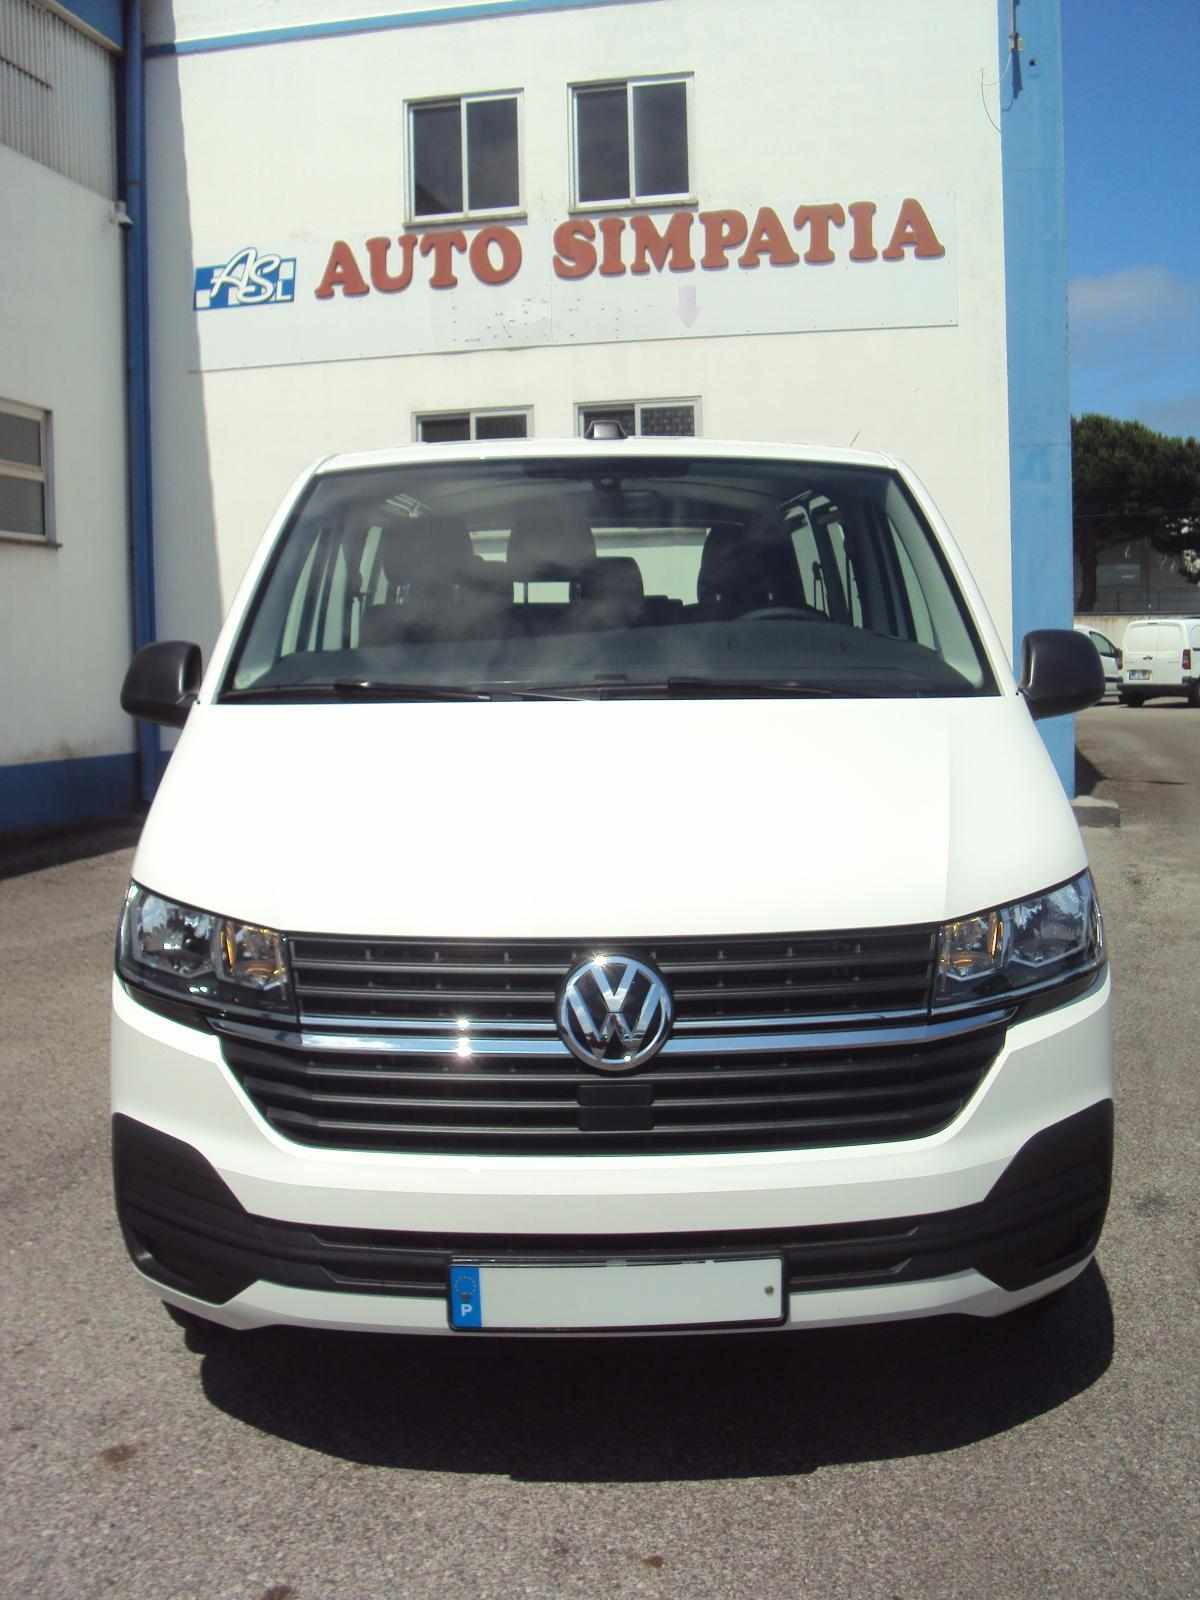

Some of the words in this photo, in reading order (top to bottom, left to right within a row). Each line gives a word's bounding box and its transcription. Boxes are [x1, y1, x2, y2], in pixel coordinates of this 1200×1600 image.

[314, 226, 522, 299] AUTO
[553, 198, 945, 280] SIMPATIA
[461, 1303, 473, 1317] P
